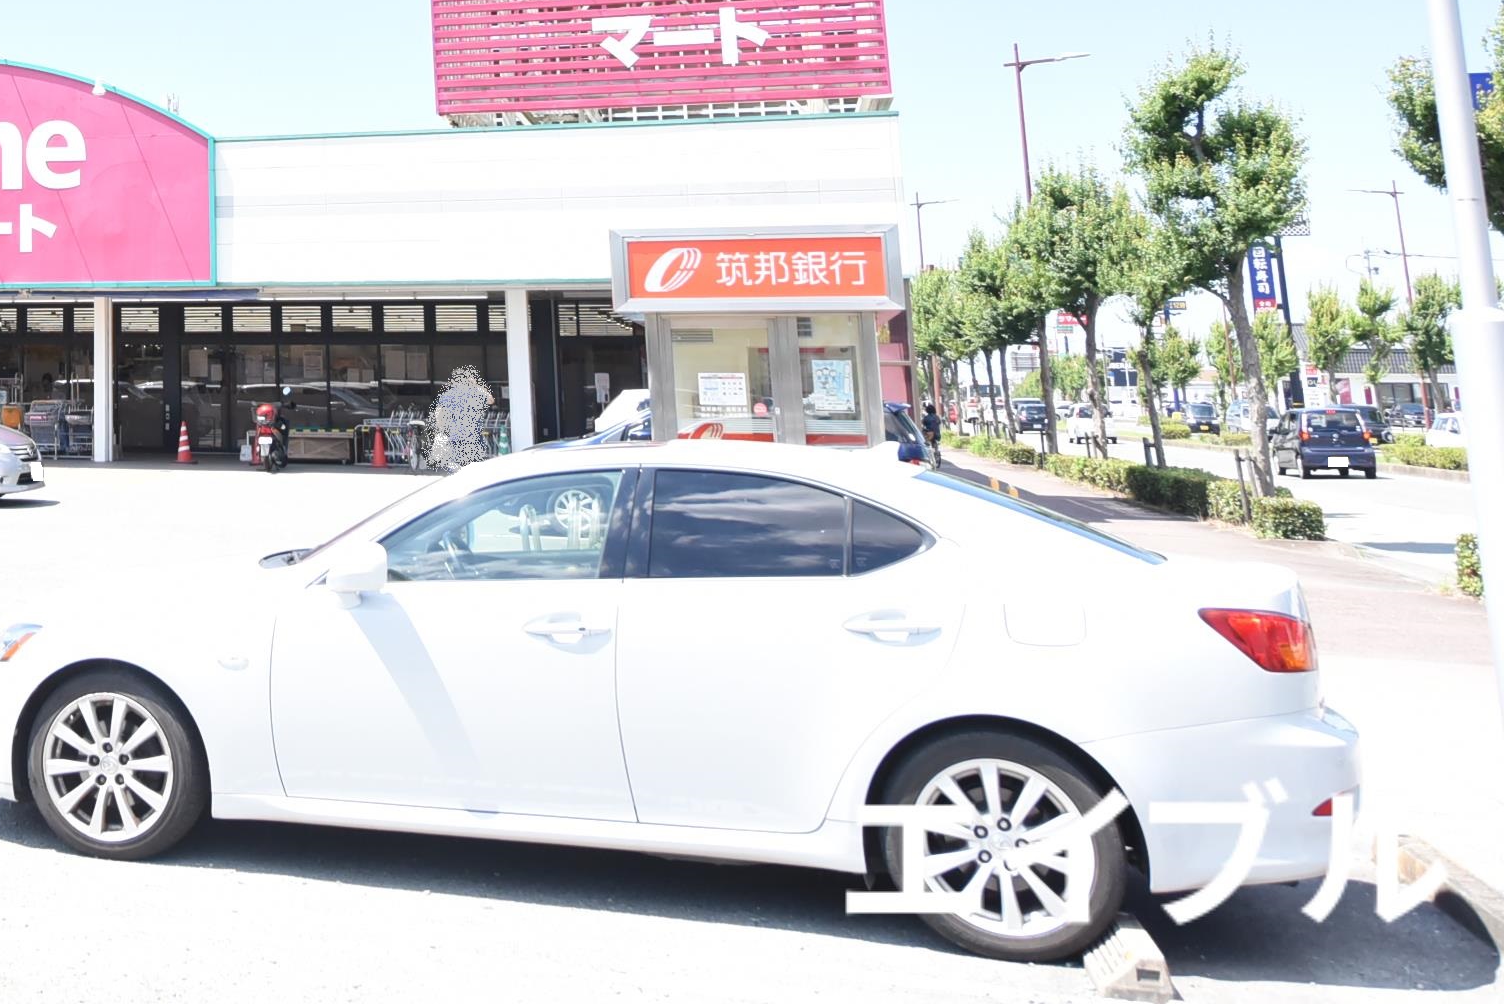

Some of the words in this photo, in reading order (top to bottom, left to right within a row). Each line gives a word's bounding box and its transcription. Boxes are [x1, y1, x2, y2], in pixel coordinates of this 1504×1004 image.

[591, 6, 769, 67] マート
[715, 251, 867, 287] 筑邦銀行
[1252, 246, 1271, 295] 回転寿司
